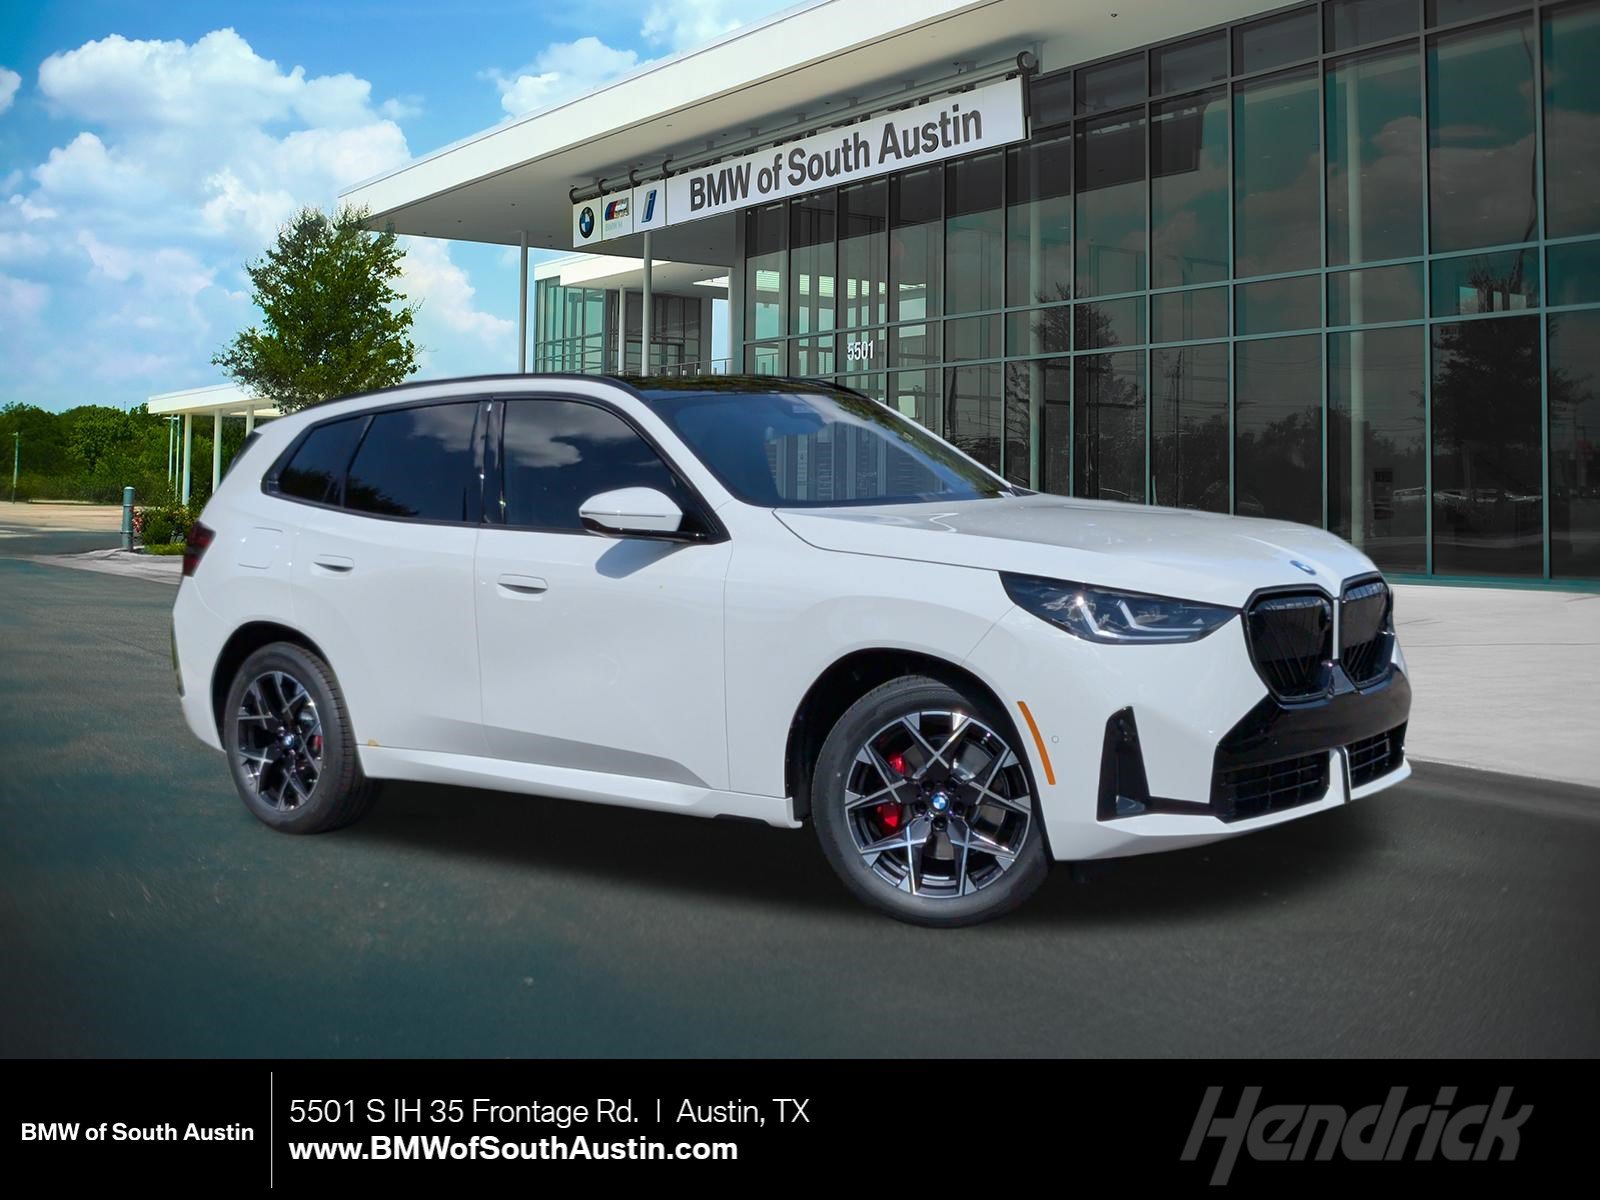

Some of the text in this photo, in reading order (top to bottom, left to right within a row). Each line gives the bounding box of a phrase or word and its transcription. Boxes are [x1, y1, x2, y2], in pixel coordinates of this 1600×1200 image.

[689, 162, 751, 212] BMW
[757, 153, 782, 194] of
[787, 132, 870, 186] South
[878, 103, 982, 164] Austin
[847, 340, 873, 360] 5501
